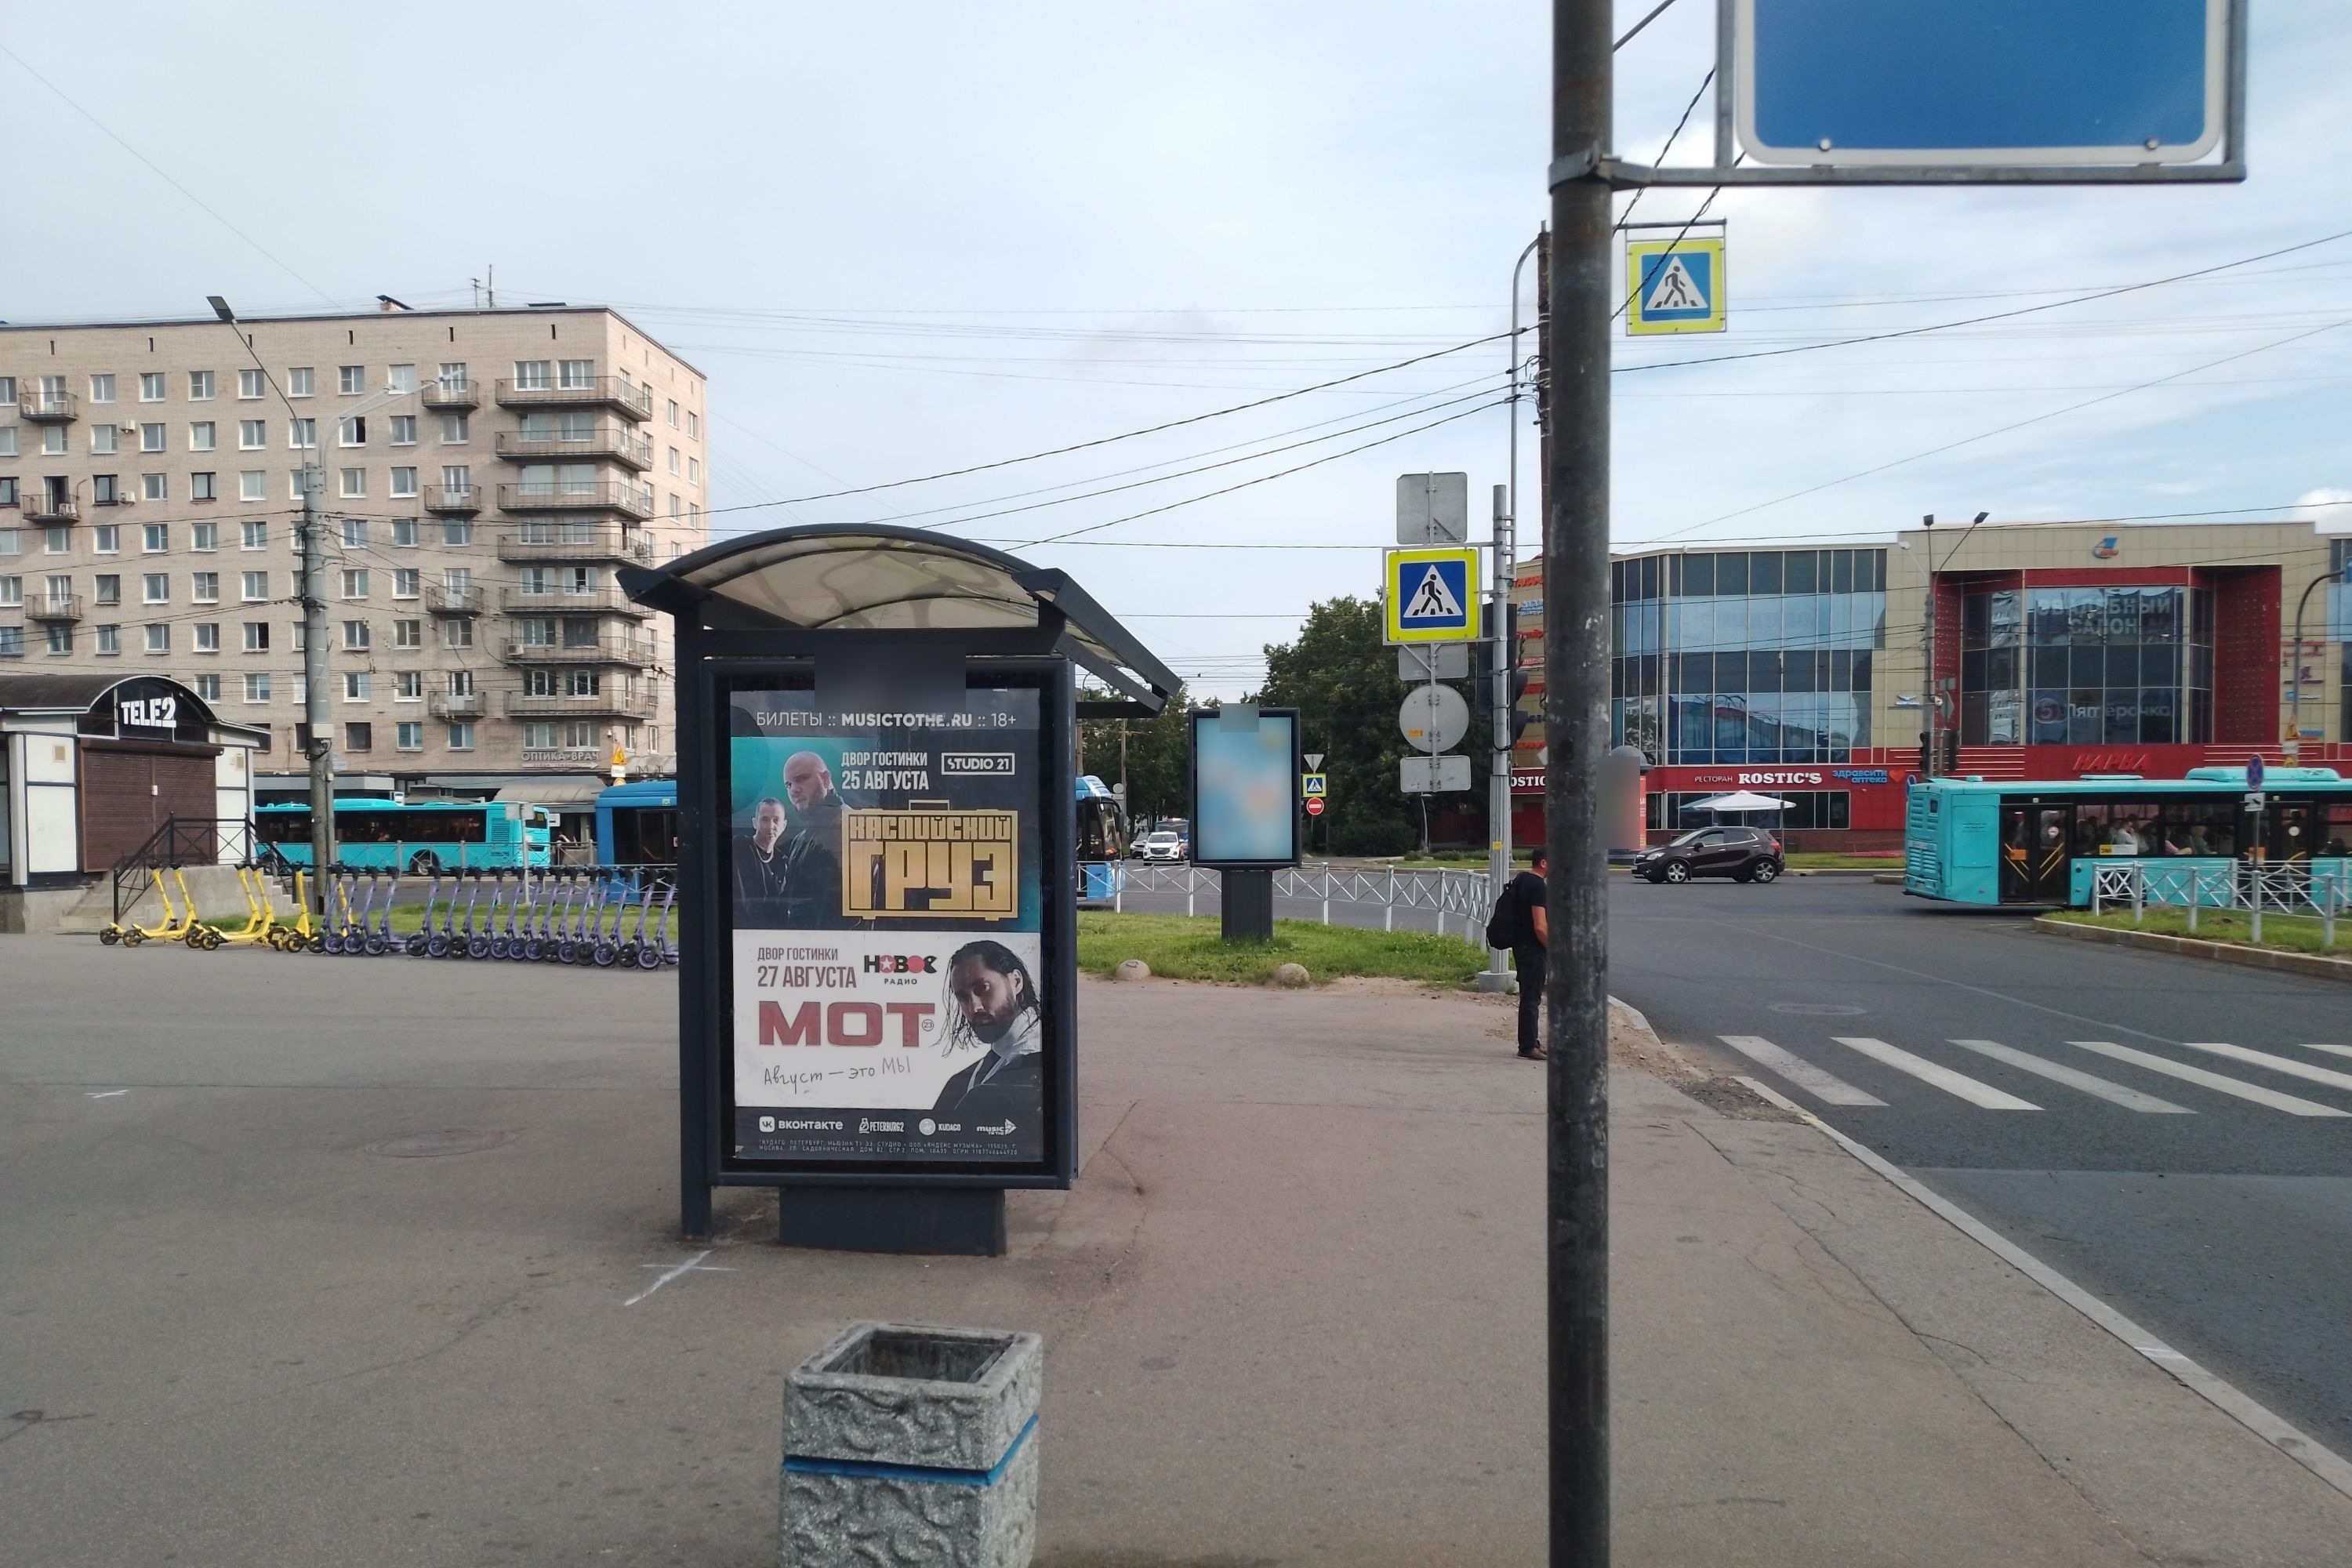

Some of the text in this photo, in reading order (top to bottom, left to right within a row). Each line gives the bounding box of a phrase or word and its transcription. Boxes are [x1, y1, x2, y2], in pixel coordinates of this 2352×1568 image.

[121, 696, 176, 728] TELE2
[757, 712, 822, 726] БИЛЕТЫ
[841, 713, 972, 727] MUSICTOTHE.RU
[991, 713, 1016, 727] 18+
[841, 752, 927, 767] ДВОР ГОСТИНКИ
[947, 758, 1009, 770] STUDIO 21
[2073, 753, 2152, 771] НАРВА
[841, 771, 929, 790] 25 АВГУСТА
[1511, 775, 1546, 787] OSTIC
[1738, 772, 1822, 784] ROSTIC'S
[849, 816, 1011, 840] КАСПИЙСКИЙ
[850, 841, 1011, 910] ГРУЗ
[757, 947, 838, 961] ДВОР ГОСТИНКИ
[757, 965, 857, 988] 27 АВГУСТА
[759, 1000, 935, 1047] МОТ
[764, 1065, 822, 1094] Август
[848, 1067, 875, 1080] это
[882, 1056, 911, 1074] МЫ
